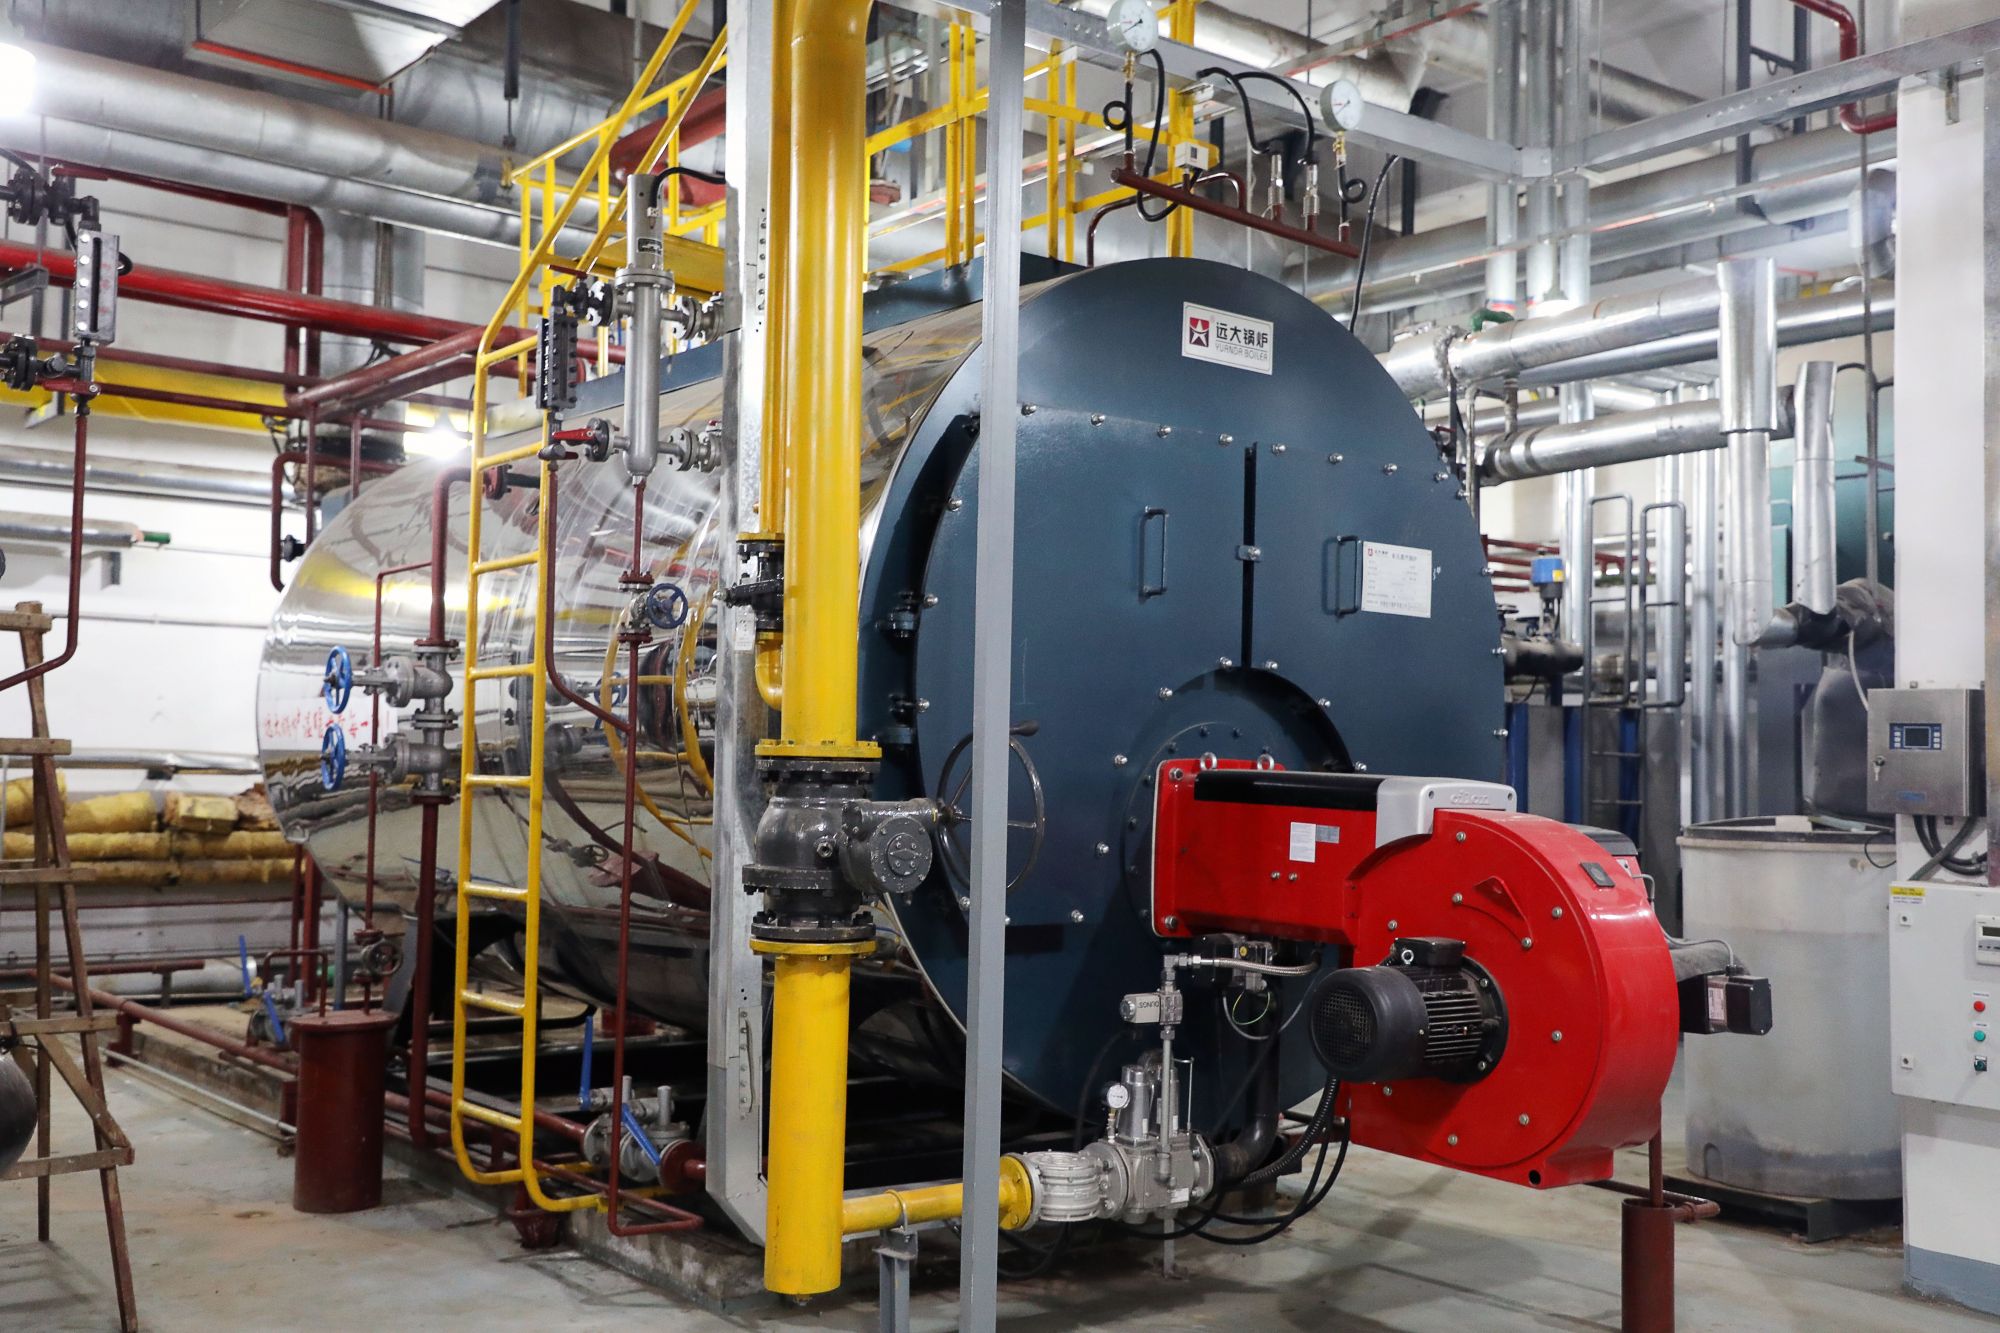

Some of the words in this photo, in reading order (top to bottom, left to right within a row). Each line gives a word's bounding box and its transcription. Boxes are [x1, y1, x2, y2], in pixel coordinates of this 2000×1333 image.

[1215, 322, 1268, 348] 远大锅炉
[1244, 348, 1268, 360] BOILER
